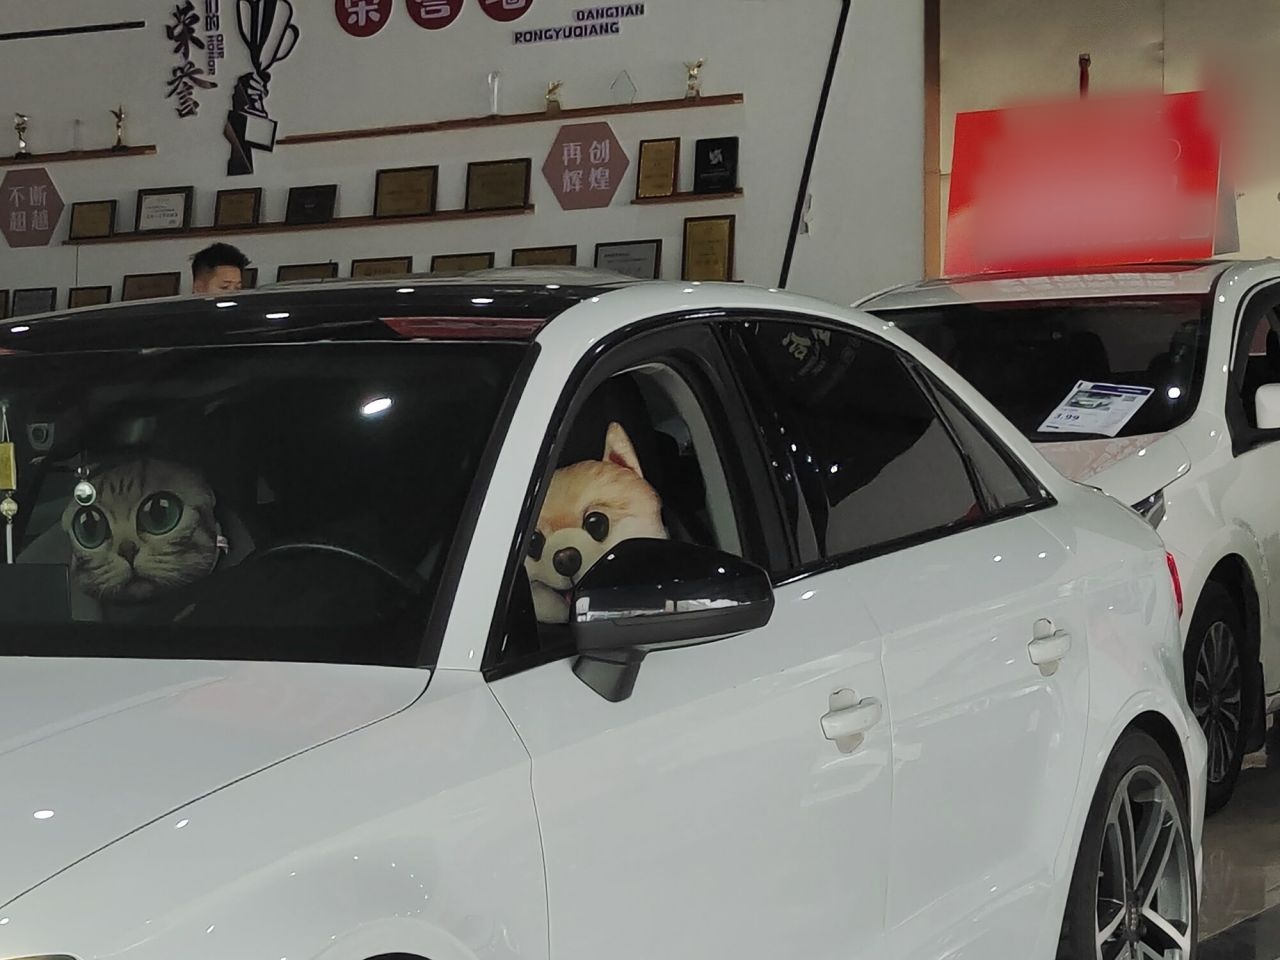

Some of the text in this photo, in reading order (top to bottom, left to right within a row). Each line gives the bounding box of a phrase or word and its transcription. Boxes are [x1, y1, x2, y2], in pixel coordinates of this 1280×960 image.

[576, 4, 645, 21] DANGJIAN
[514, 22, 620, 43] RONGYUQIANG
[561, 139, 610, 166] 再创
